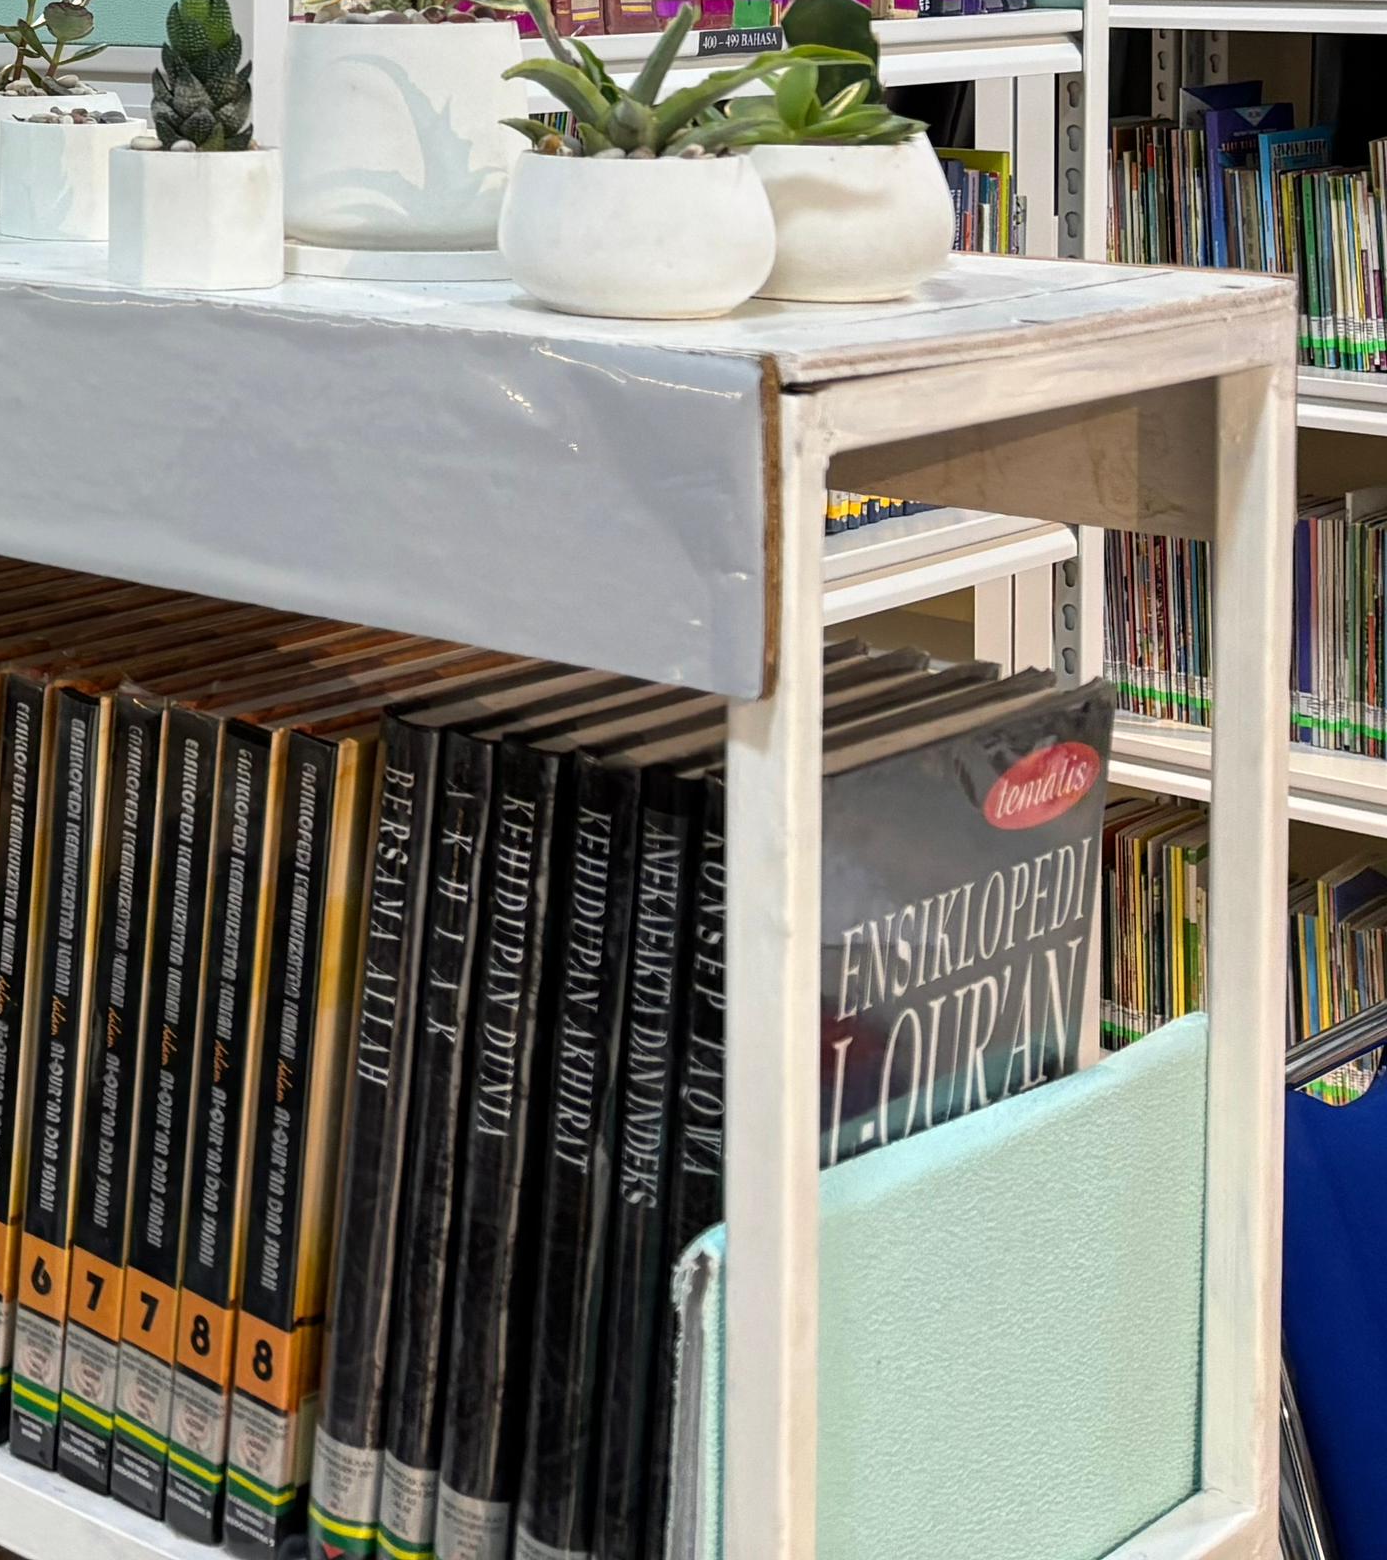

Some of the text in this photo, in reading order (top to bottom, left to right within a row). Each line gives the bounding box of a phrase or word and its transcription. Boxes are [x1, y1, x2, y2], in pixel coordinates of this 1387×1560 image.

[702, 35, 717, 49] 400
[725, 34, 740, 48] 499
[741, 32, 778, 47] BAHASA
[995, 754, 1088, 820] tematis
[356, 764, 415, 1088] BERSAMA ALLAH
[835, 837, 1093, 1023] ENSIKLOPEDI
[476, 793, 536, 1137] KEHIDUPAN DUNIA
[554, 806, 612, 1175] KEHIDUPAN AKHIRAT
[619, 1091, 664, 1209] INDEKS
[31, 1256, 53, 1296] 6
[85, 1272, 105, 1311] 7
[138, 1291, 159, 1332] 7
[190, 1314, 211, 1356] 8
[252, 1340, 274, 1381] 8
